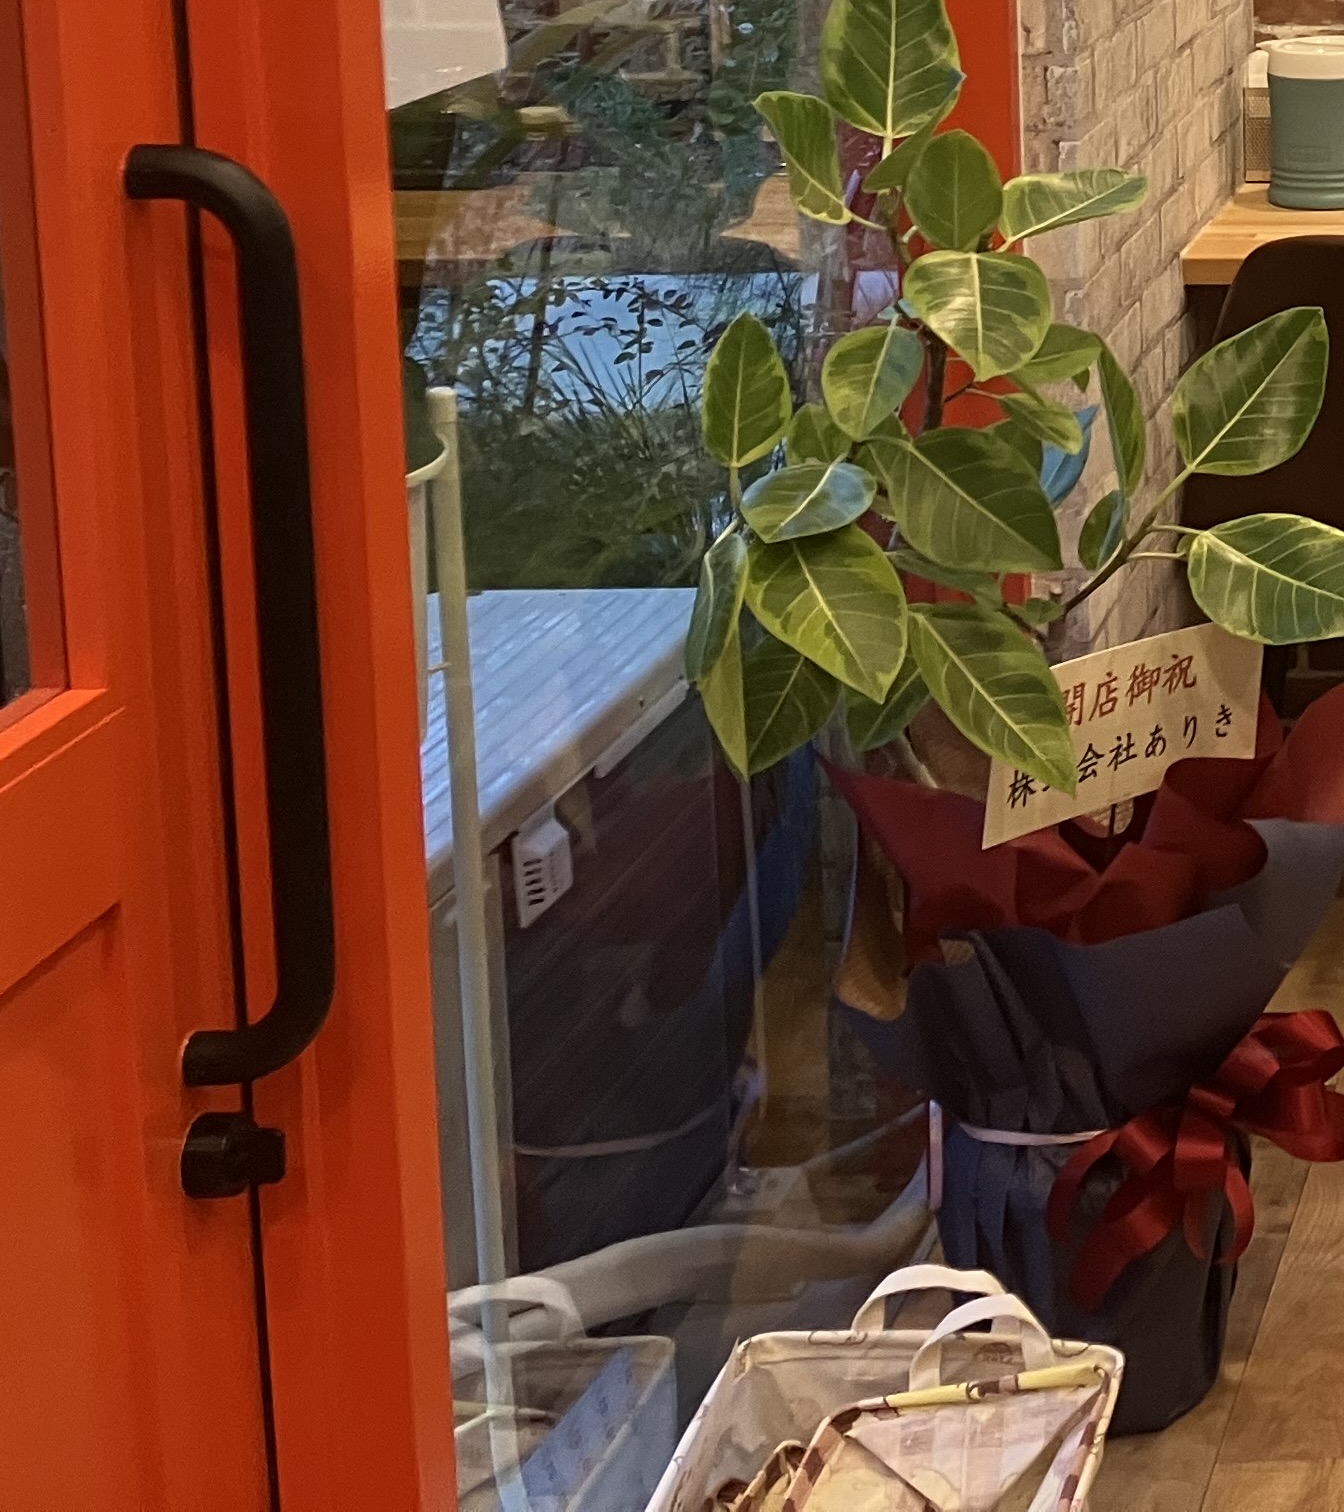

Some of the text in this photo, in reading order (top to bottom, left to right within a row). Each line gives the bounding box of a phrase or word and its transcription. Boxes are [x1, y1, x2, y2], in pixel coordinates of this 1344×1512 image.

[1061, 653, 1197, 728] 開店御祝
[1006, 704, 1233, 809] 株会社ありき
